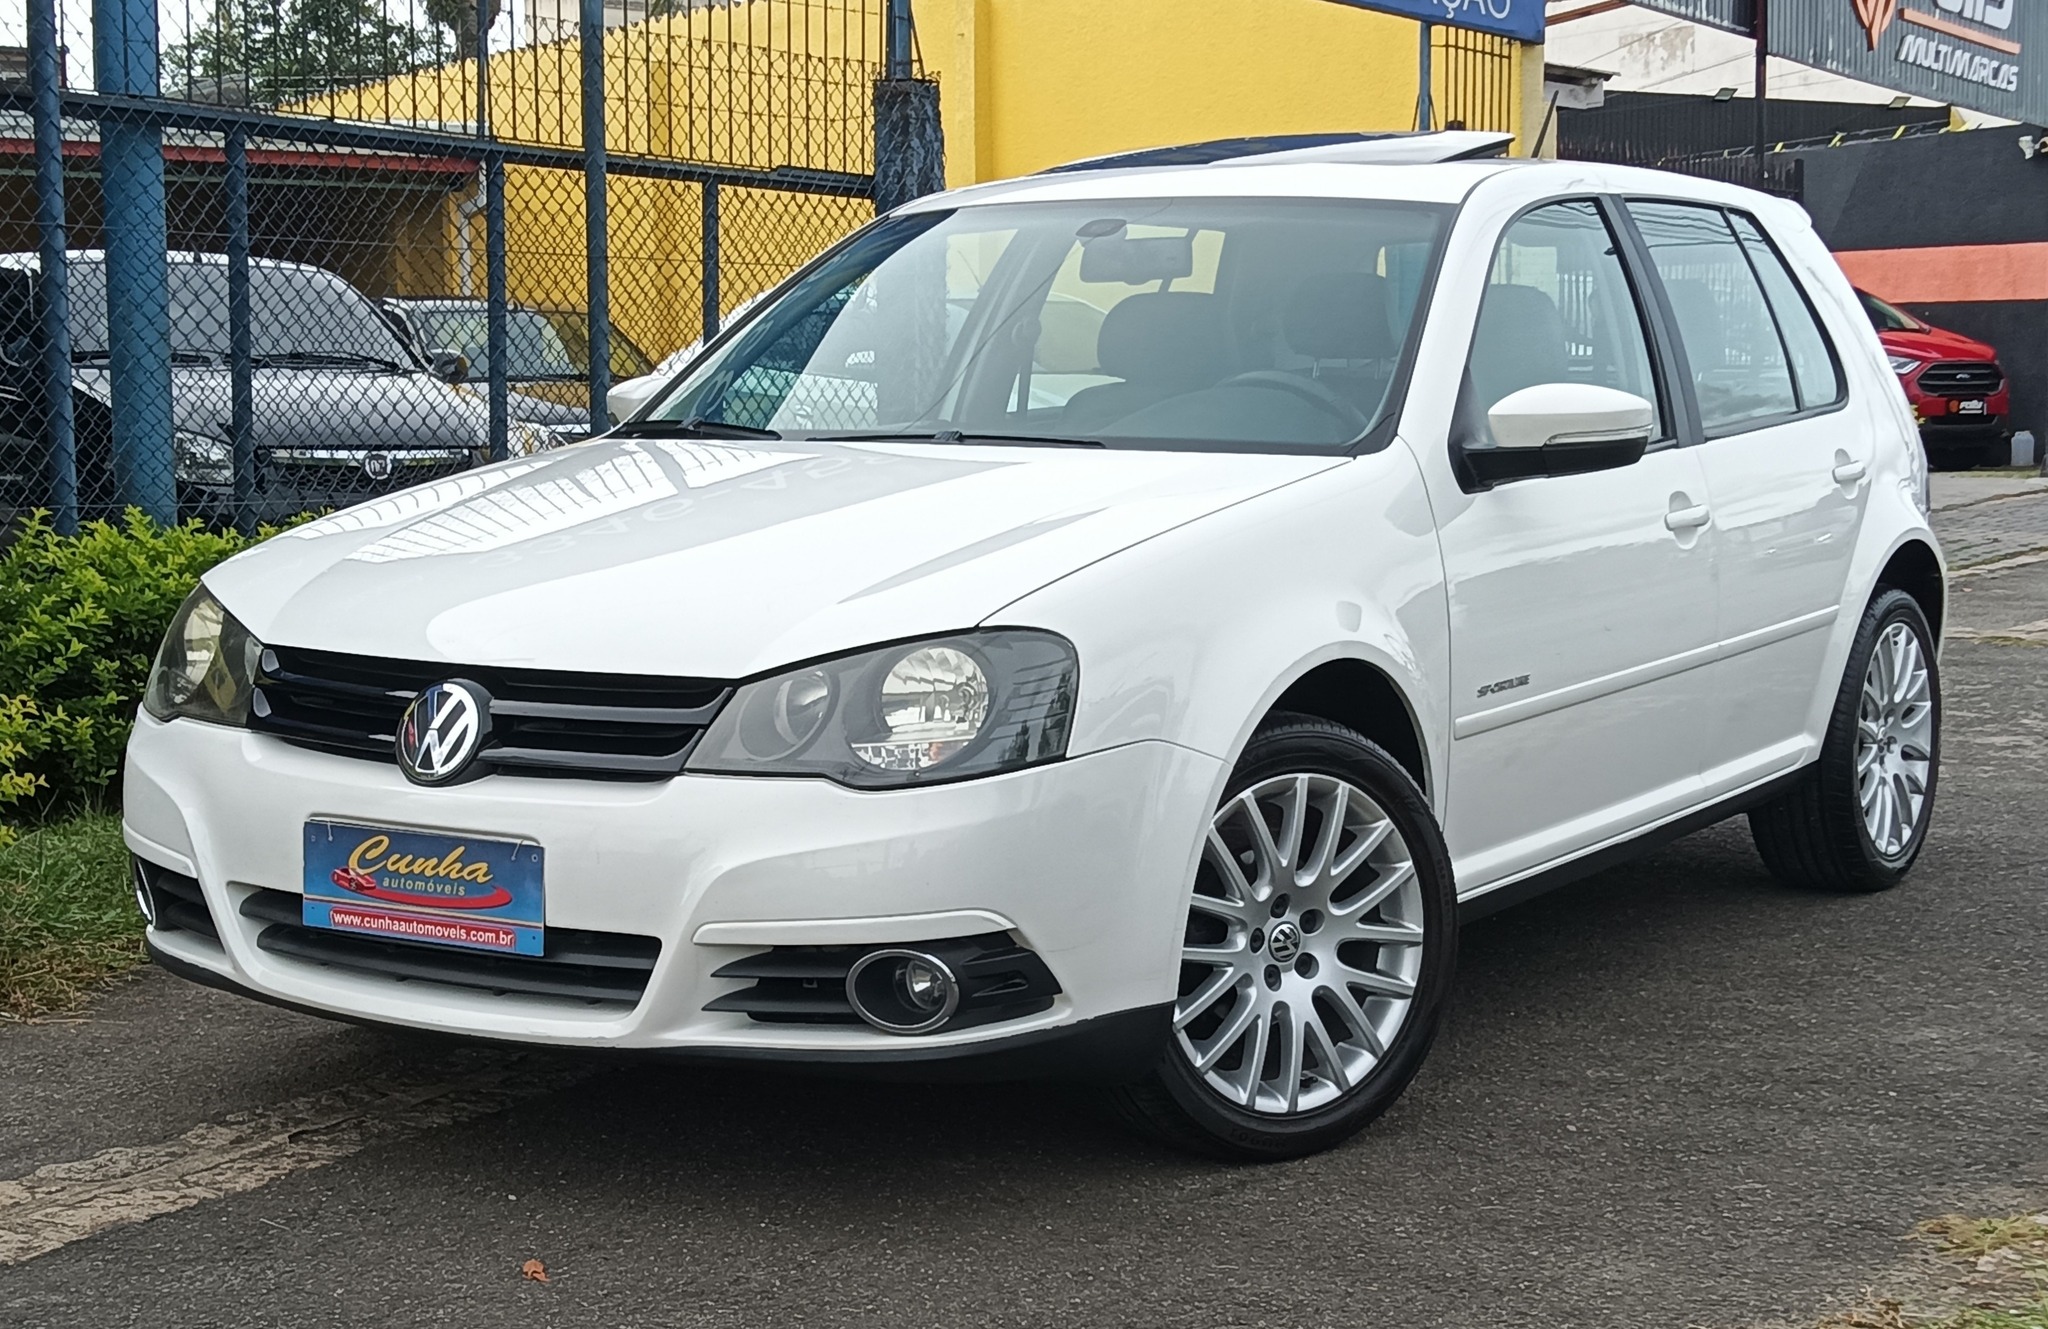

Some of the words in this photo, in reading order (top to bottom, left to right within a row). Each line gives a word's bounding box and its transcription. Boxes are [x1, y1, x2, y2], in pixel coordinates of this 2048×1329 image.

[1899, 34, 2019, 92] MULTIMARCAS
[347, 834, 494, 884] Cunha
[382, 876, 466, 897] automóveis
[333, 910, 513, 947] www.cunhaautomoveis.com.br
